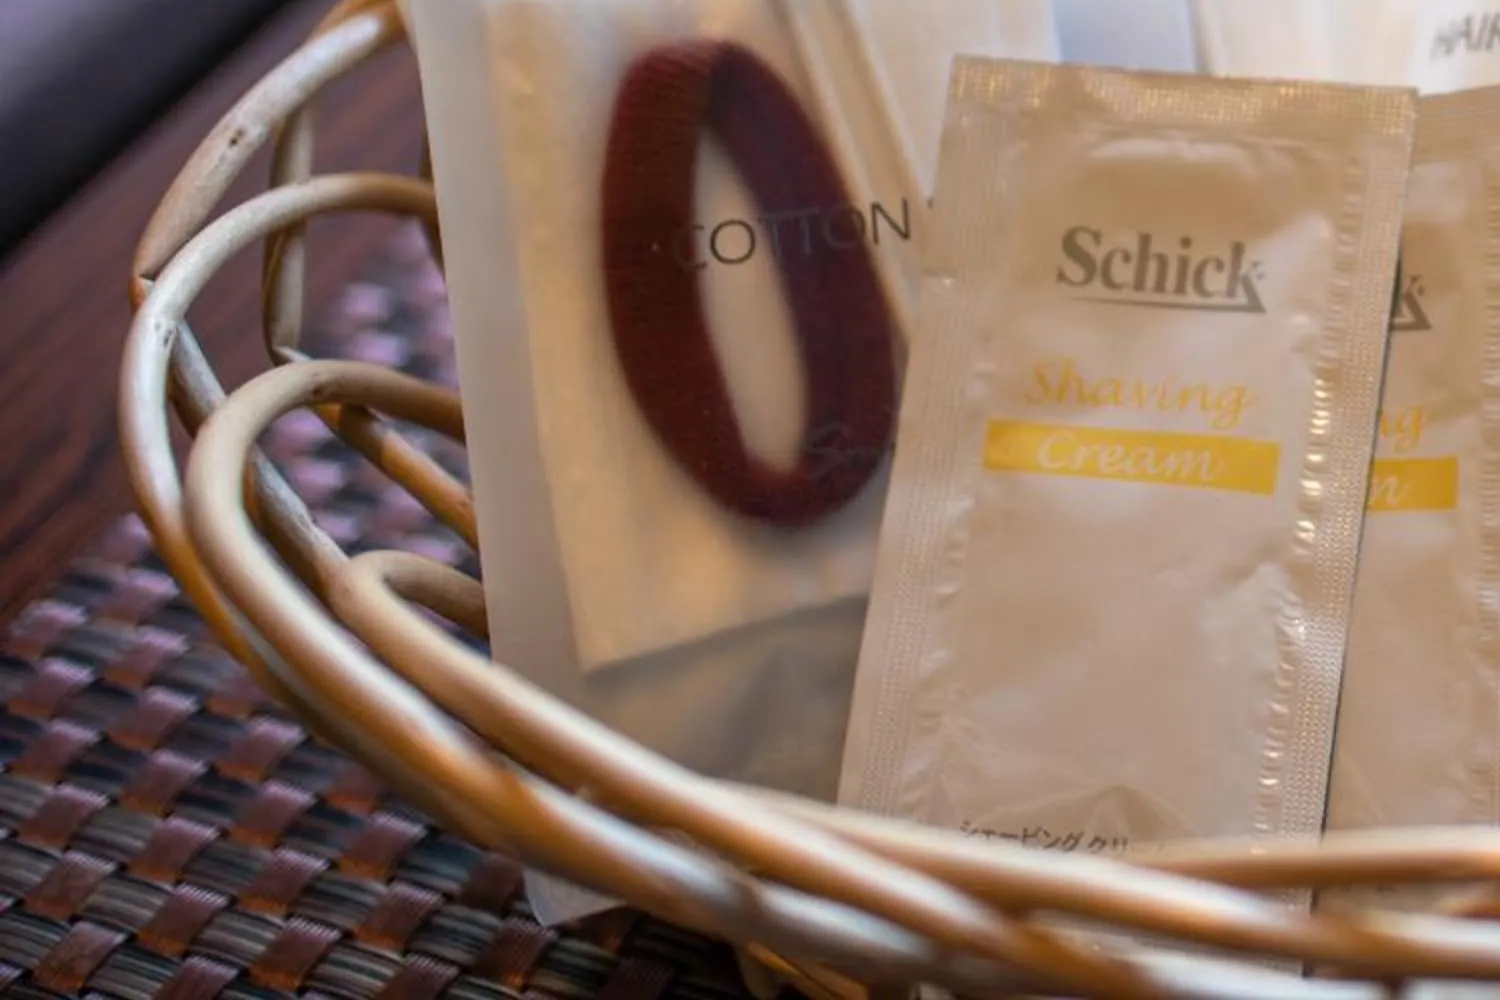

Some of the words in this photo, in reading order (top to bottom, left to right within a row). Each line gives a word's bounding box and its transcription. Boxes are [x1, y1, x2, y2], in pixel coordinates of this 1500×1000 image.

[672, 196, 911, 270] COTTON
[1056, 225, 1266, 314] Schick
[1024, 357, 1256, 430] Shaving
[1037, 430, 1226, 482] Cream
